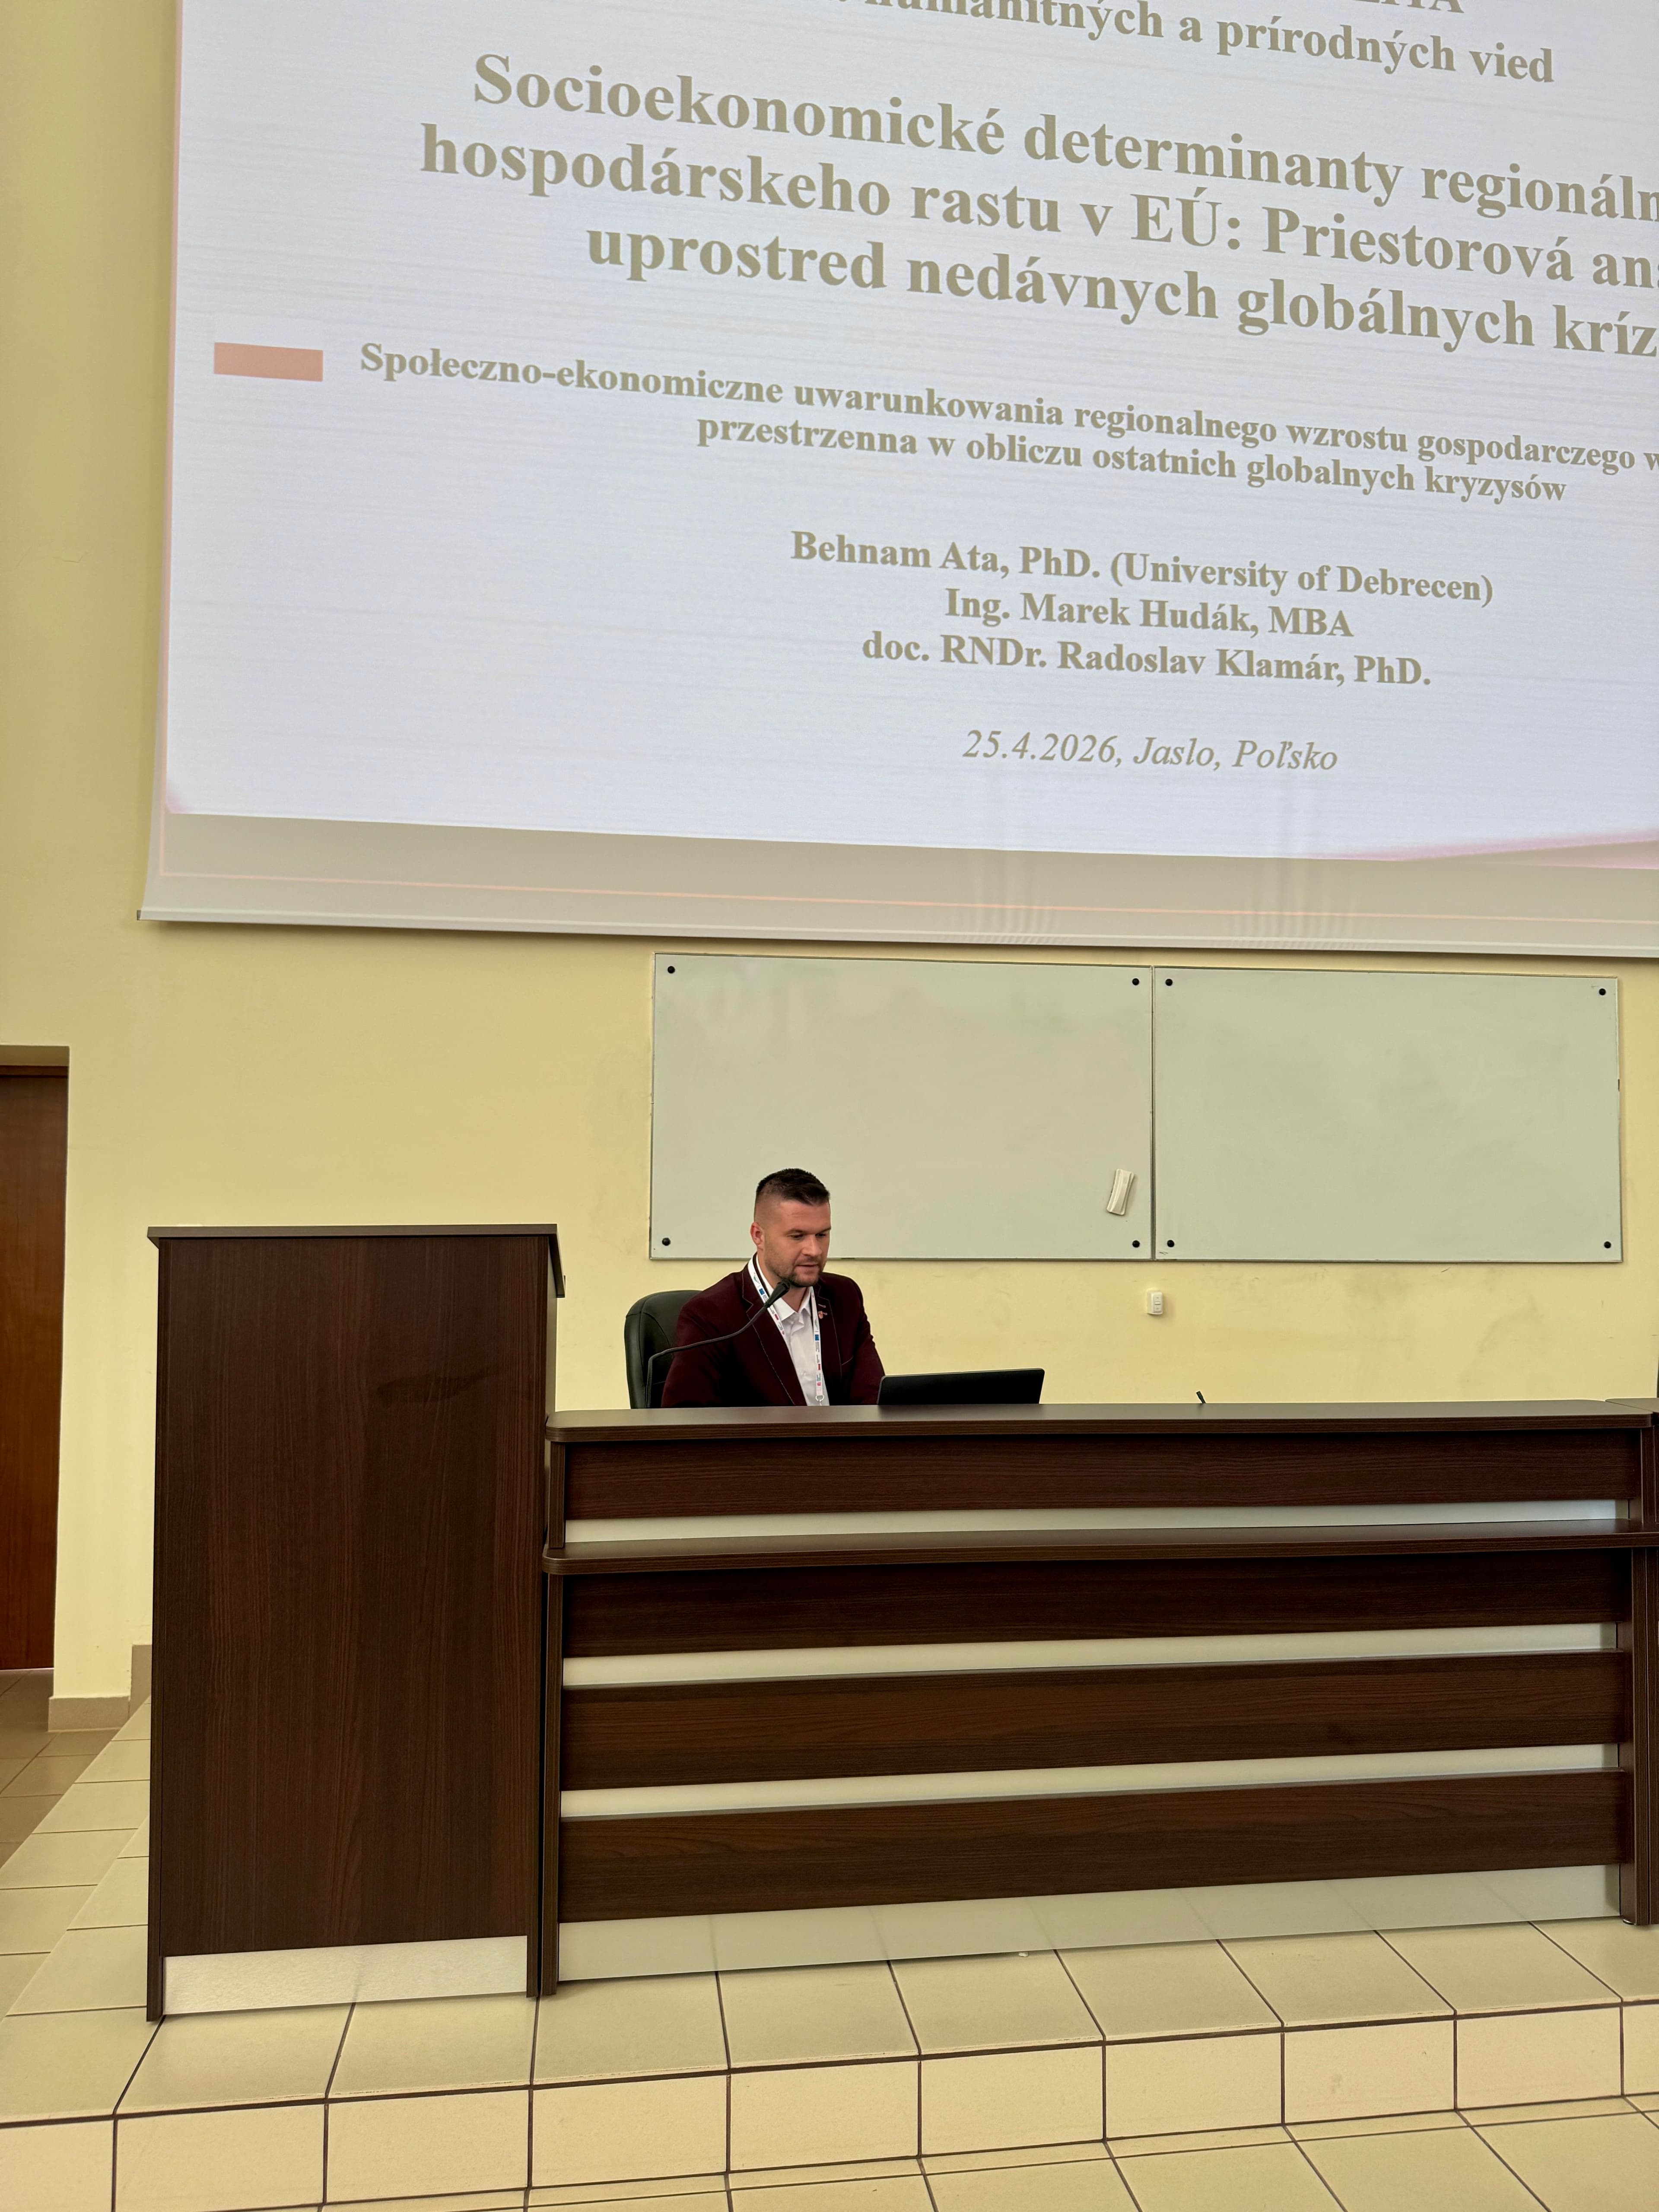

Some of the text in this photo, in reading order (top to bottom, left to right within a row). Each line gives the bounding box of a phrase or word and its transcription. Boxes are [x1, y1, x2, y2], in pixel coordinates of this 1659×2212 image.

[864, 0, 1554, 83] manitných a prírodných vied
[475, 54, 1004, 155] Socioekonomické
[1025, 114, 1404, 207] determinanty
[421, 123, 1659, 288] hospodárskeho rastu v EÚ: Priestorová an
[587, 230, 1656, 356] uprostred nedávnych globálnych kríz
[362, 343, 783, 403] Społeczno-ekonomiczne
[795, 386, 1063, 425] uwarunkowania
[1075, 405, 1276, 448] regionalnego
[1286, 425, 1408, 451] wzrostu
[1418, 435, 1635, 475] gospodarczego
[698, 420, 1566, 504] przestrzenna w obliczu ostatnich globalnych kryzysów
[791, 531, 1492, 607] Behnam Ata, PhD. (University of Debrecen)
[945, 588, 1354, 638] Ing. Marek Hudák, MBA
[863, 631, 1430, 686] doc. RNDr. Radoslav Klamár, PhD.
[963, 730, 1337, 770] 25.4.2026, Jaslo, Poľsko
